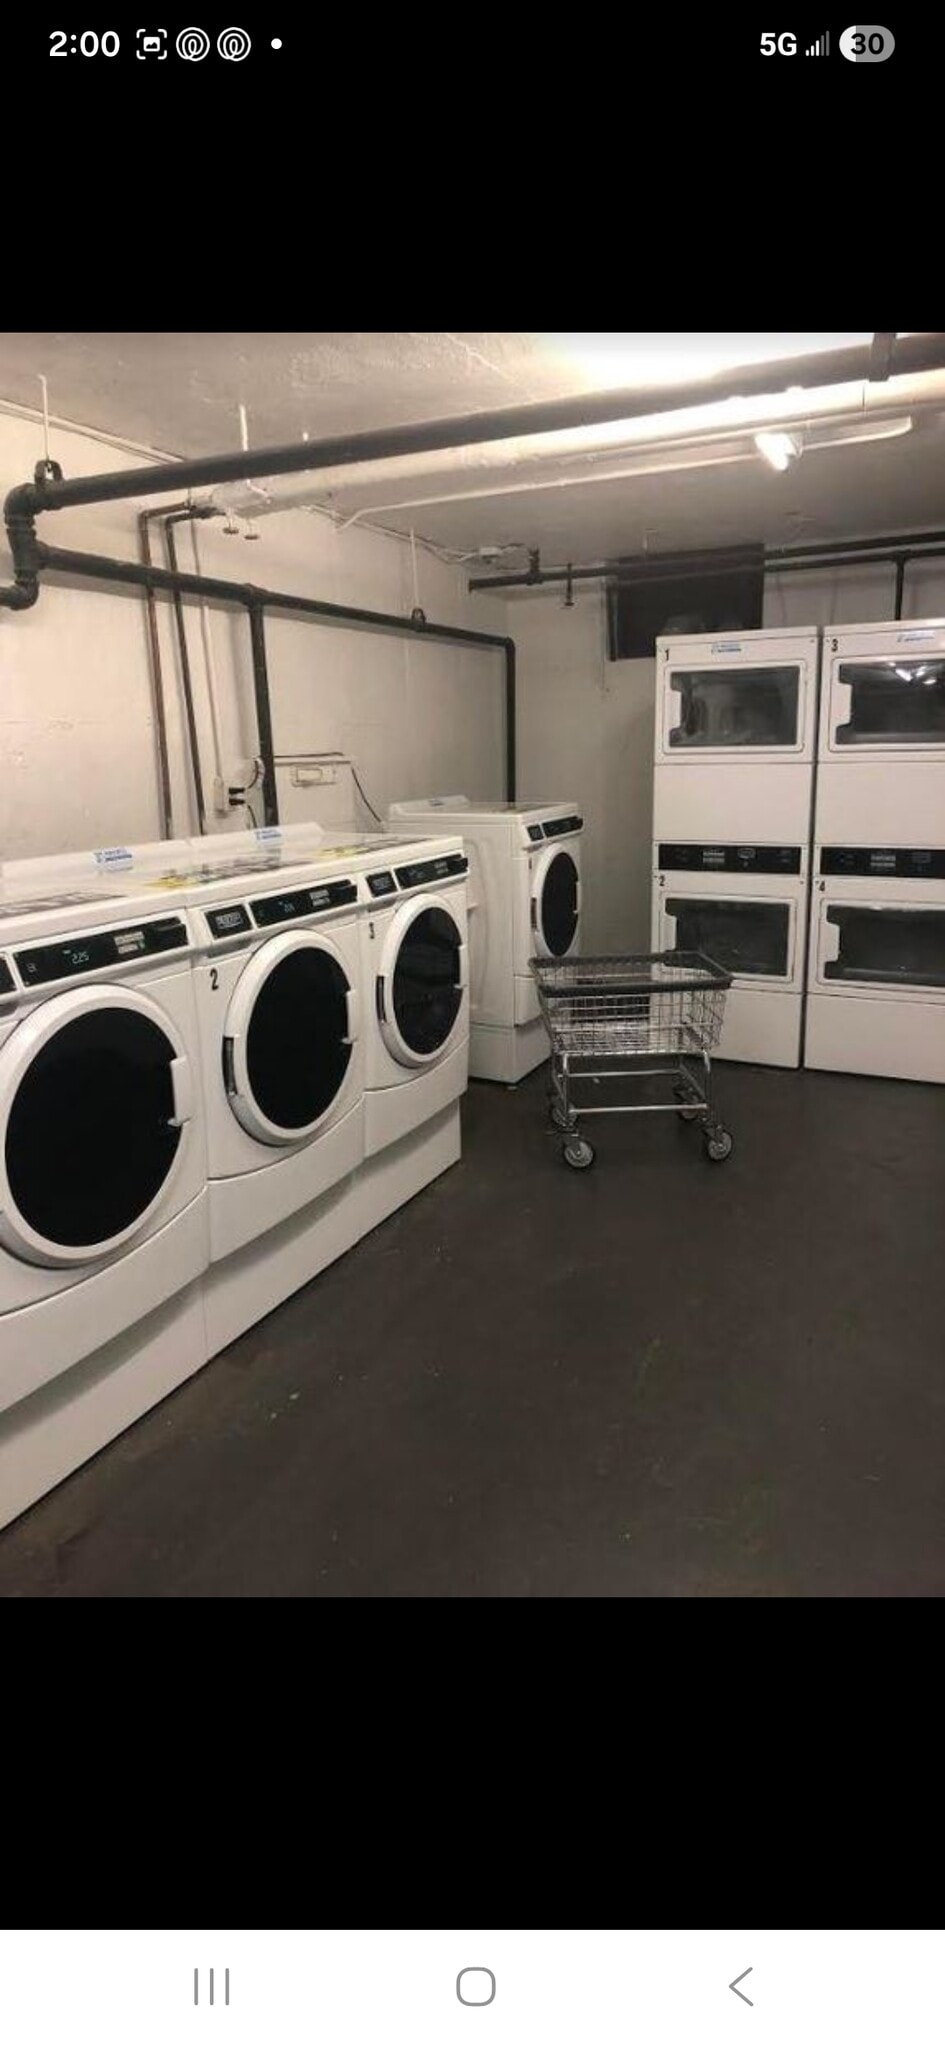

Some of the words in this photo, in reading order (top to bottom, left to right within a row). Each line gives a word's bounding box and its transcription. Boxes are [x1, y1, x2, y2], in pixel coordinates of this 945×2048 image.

[831, 638, 839, 652] 3
[664, 648, 670, 661] 1
[659, 875, 666, 887] 2
[818, 880, 826, 892] 4
[209, 967, 220, 991] 2
